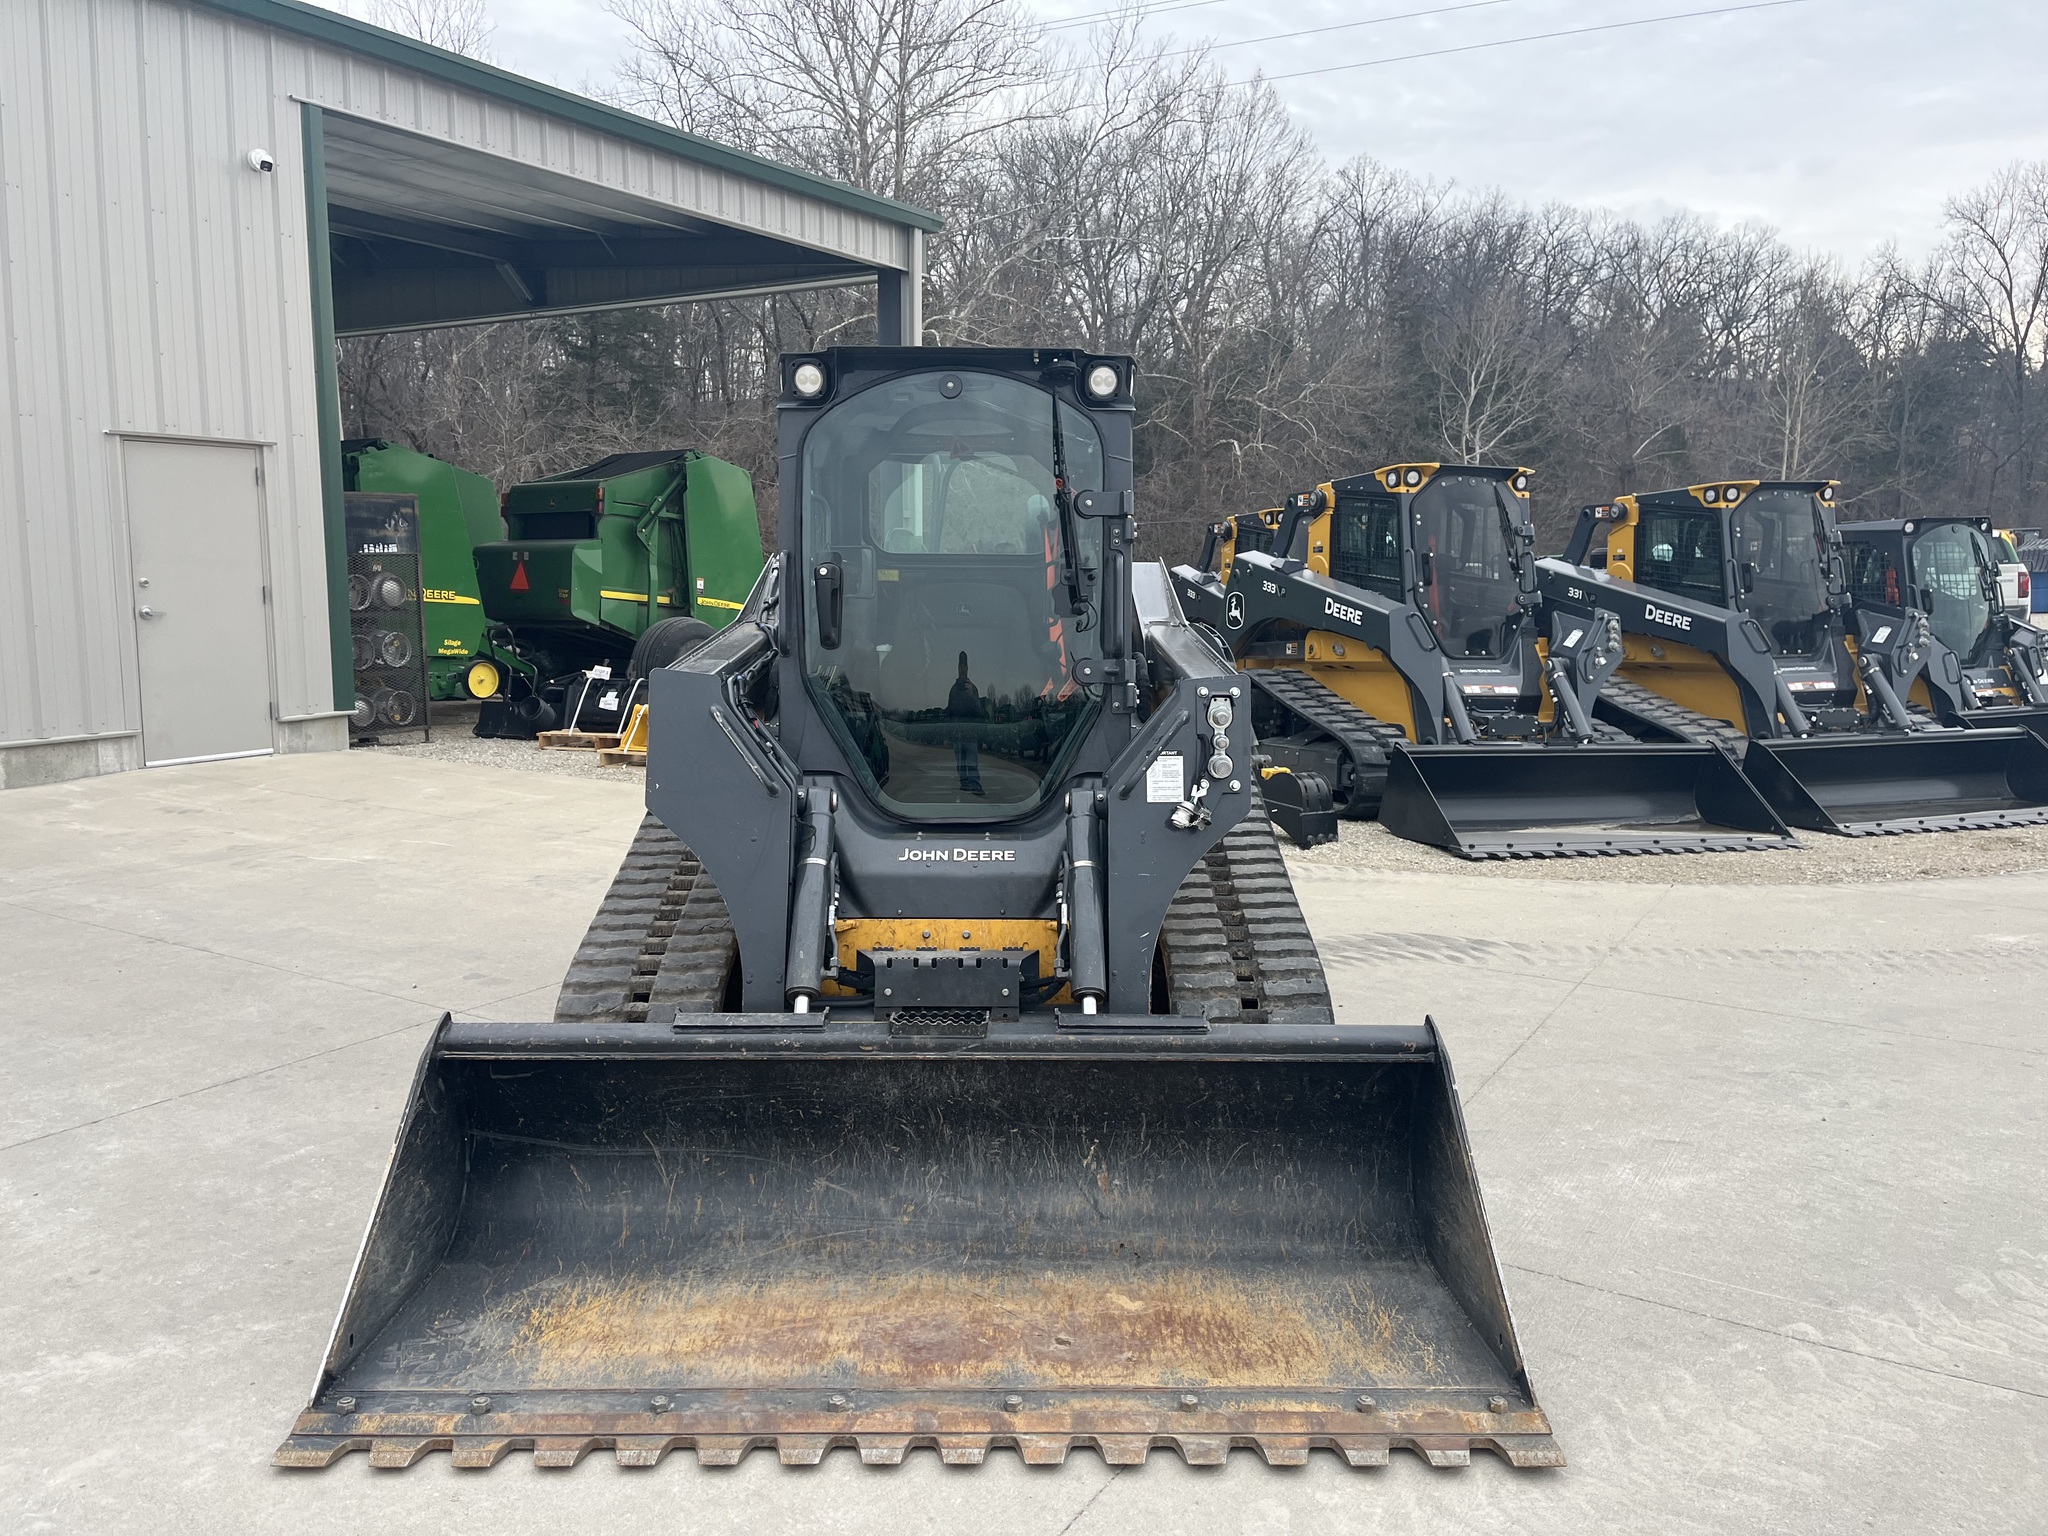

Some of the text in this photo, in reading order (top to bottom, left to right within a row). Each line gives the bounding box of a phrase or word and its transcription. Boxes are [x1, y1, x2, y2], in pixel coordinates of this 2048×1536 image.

[1262, 580, 1276, 594] 333
[1567, 587, 1583, 600] 331
[1324, 596, 1363, 626] DEERE
[1644, 603, 1692, 631] DEERE
[444, 639, 461, 647] Silage
[898, 848, 1016, 862] JOHN DEERE
